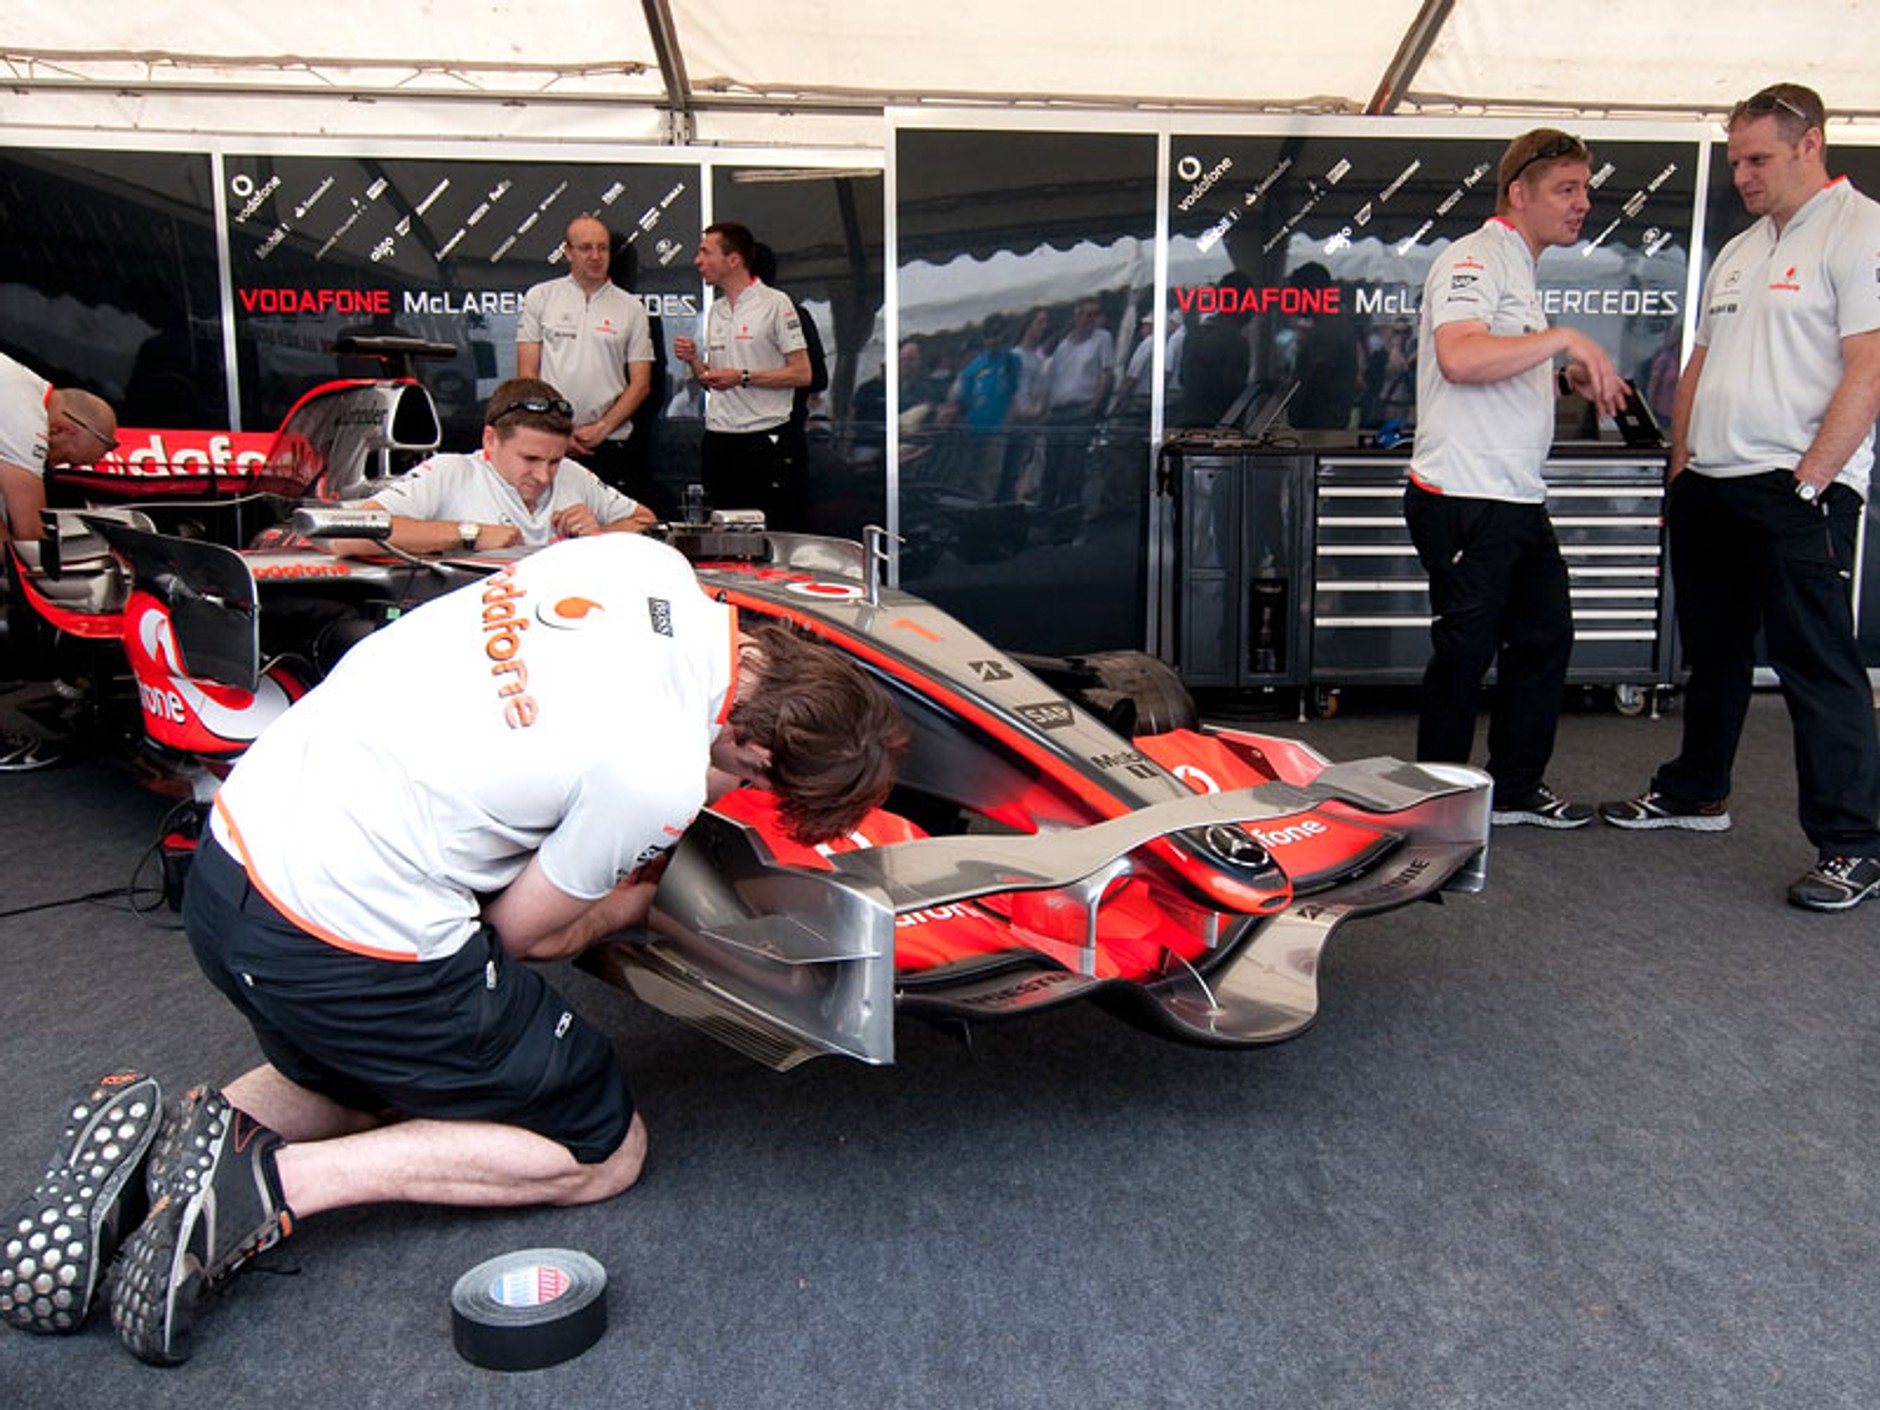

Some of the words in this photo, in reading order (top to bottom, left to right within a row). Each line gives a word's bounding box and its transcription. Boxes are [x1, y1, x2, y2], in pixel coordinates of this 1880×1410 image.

[1178, 156, 1233, 212] vodafone
[235, 176, 281, 223] vodafone
[238, 288, 391, 315] VODAFONE
[1175, 287, 1341, 314] VODAFONE
[252, 563, 350, 579] vodafone
[1023, 705, 1069, 725] SAP
